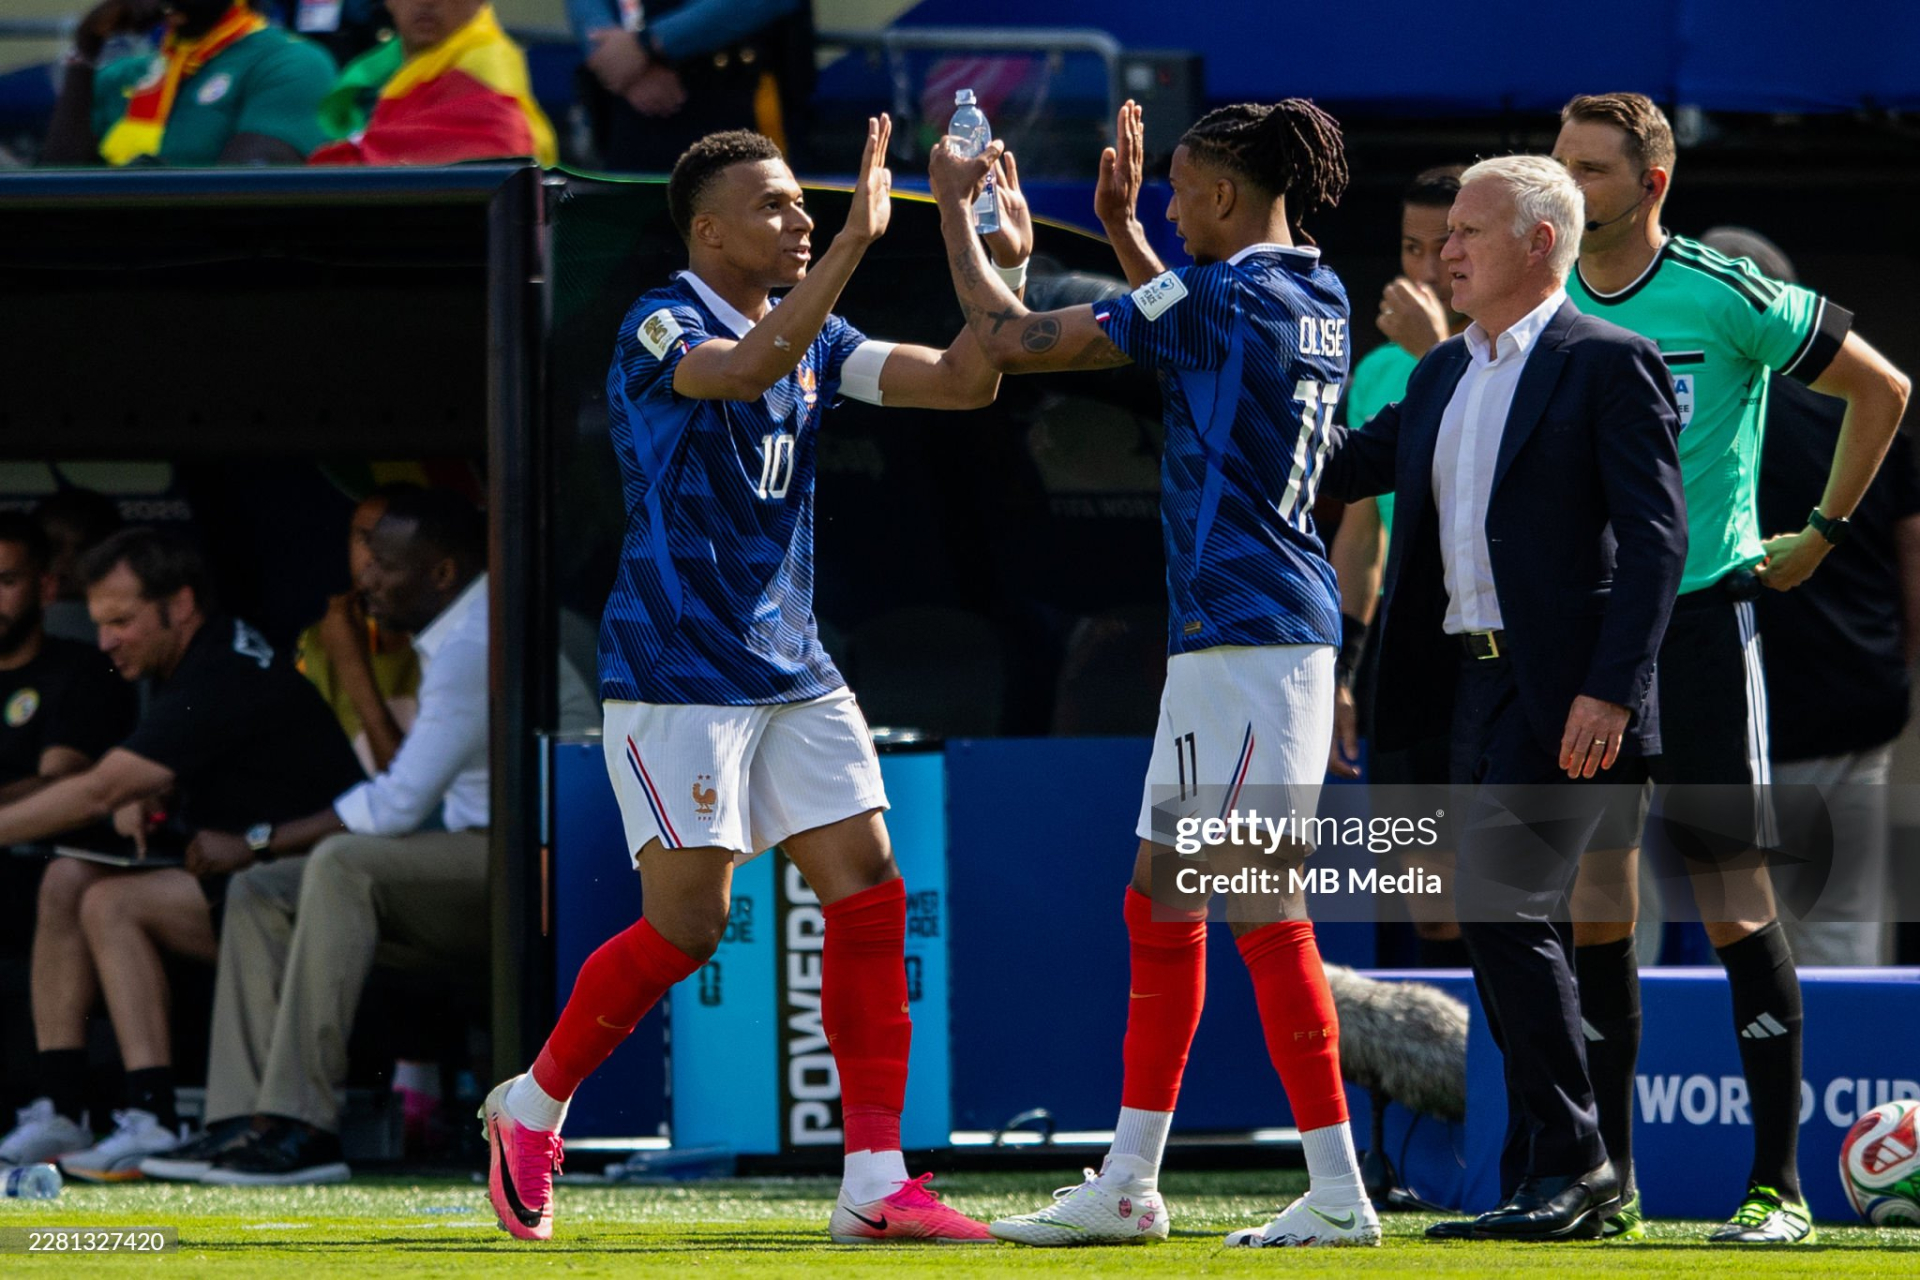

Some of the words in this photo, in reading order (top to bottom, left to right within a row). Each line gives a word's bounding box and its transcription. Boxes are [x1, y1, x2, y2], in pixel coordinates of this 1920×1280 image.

[1299, 315, 1346, 357] OLISE
[758, 434, 795, 500] 10
[1277, 380, 1340, 534] 11
[1174, 731, 1198, 803] 11
